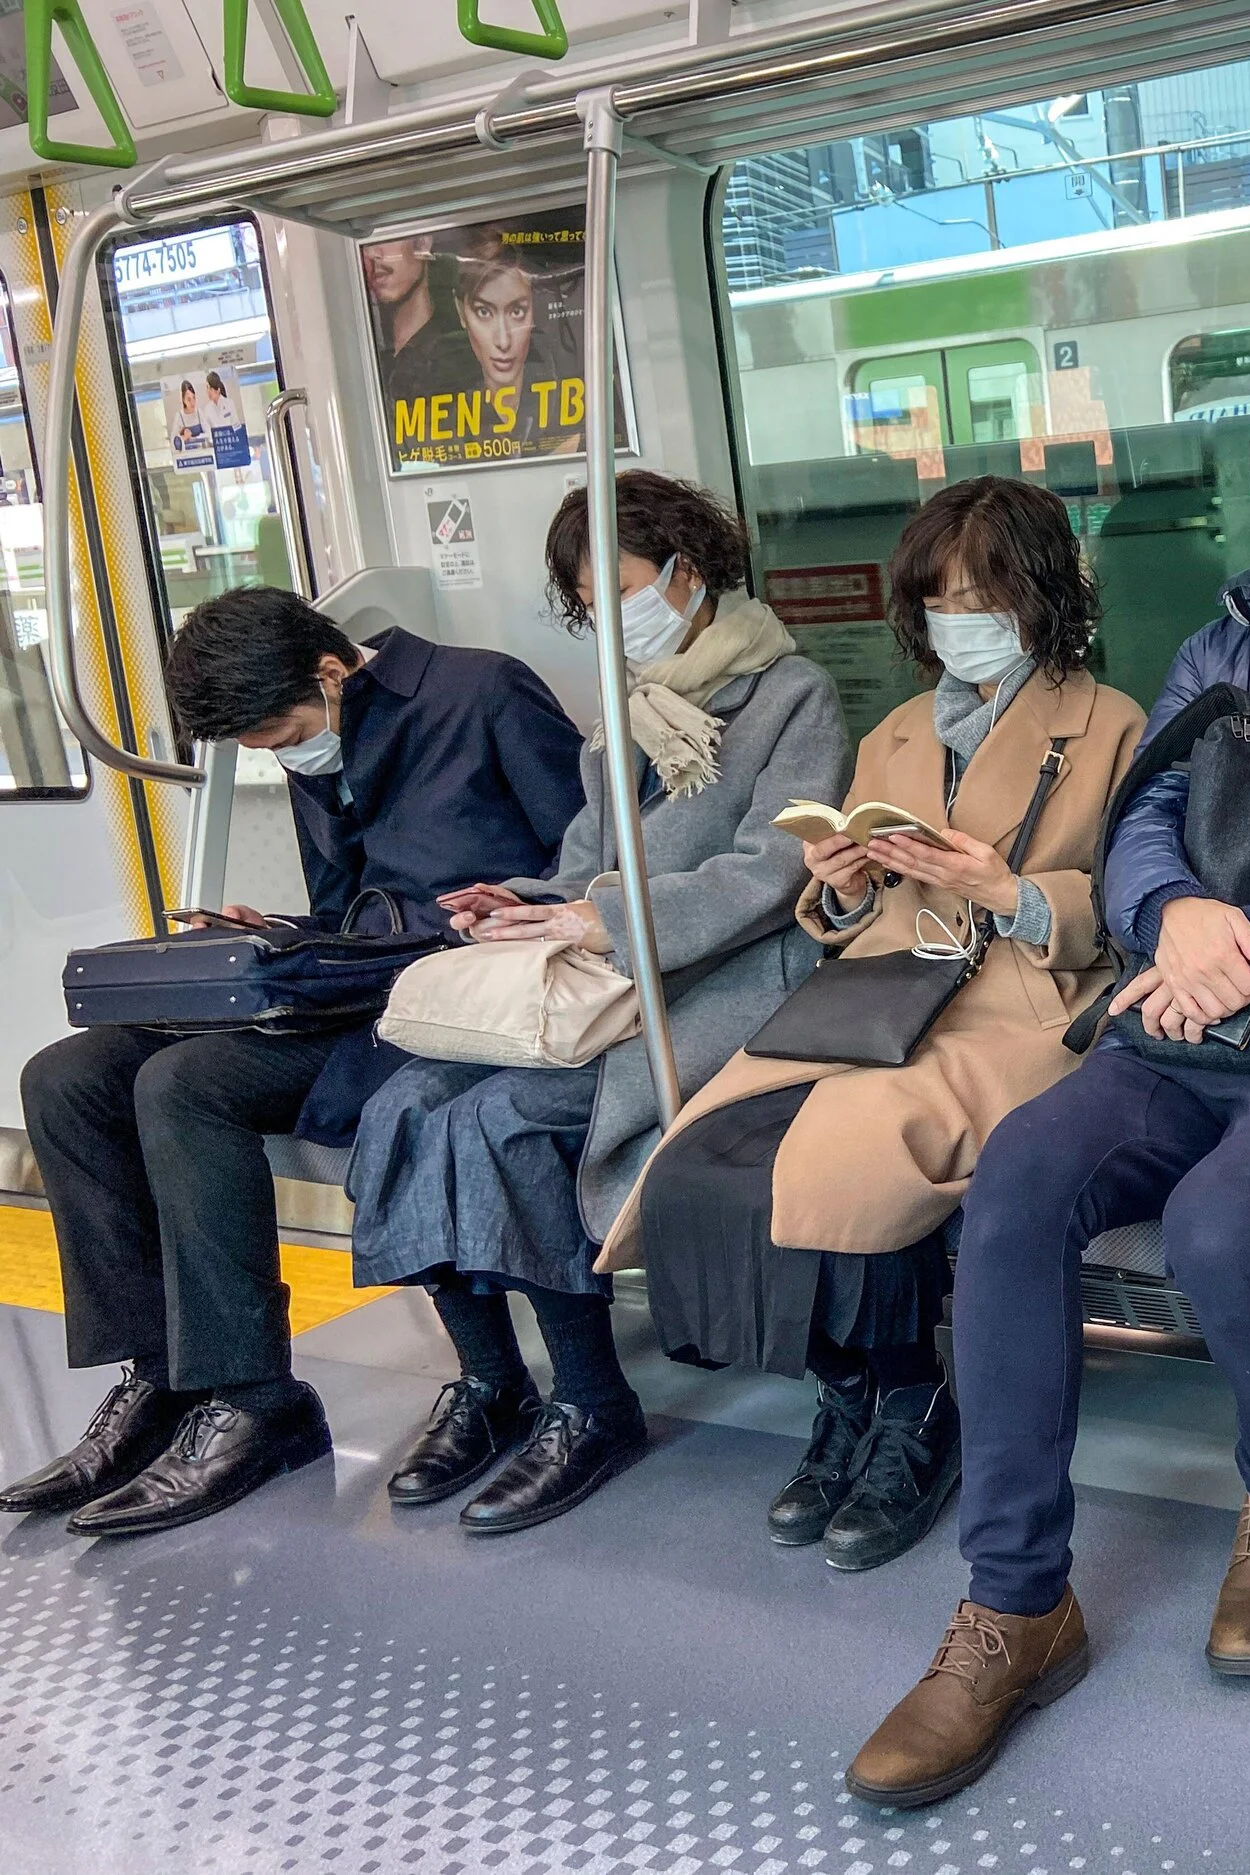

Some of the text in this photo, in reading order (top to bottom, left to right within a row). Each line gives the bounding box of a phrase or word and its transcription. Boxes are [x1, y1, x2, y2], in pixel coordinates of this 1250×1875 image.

[1059, 346, 1074, 367] 2
[395, 386, 517, 445] MEN'S
[483, 437, 521, 458] 500円
